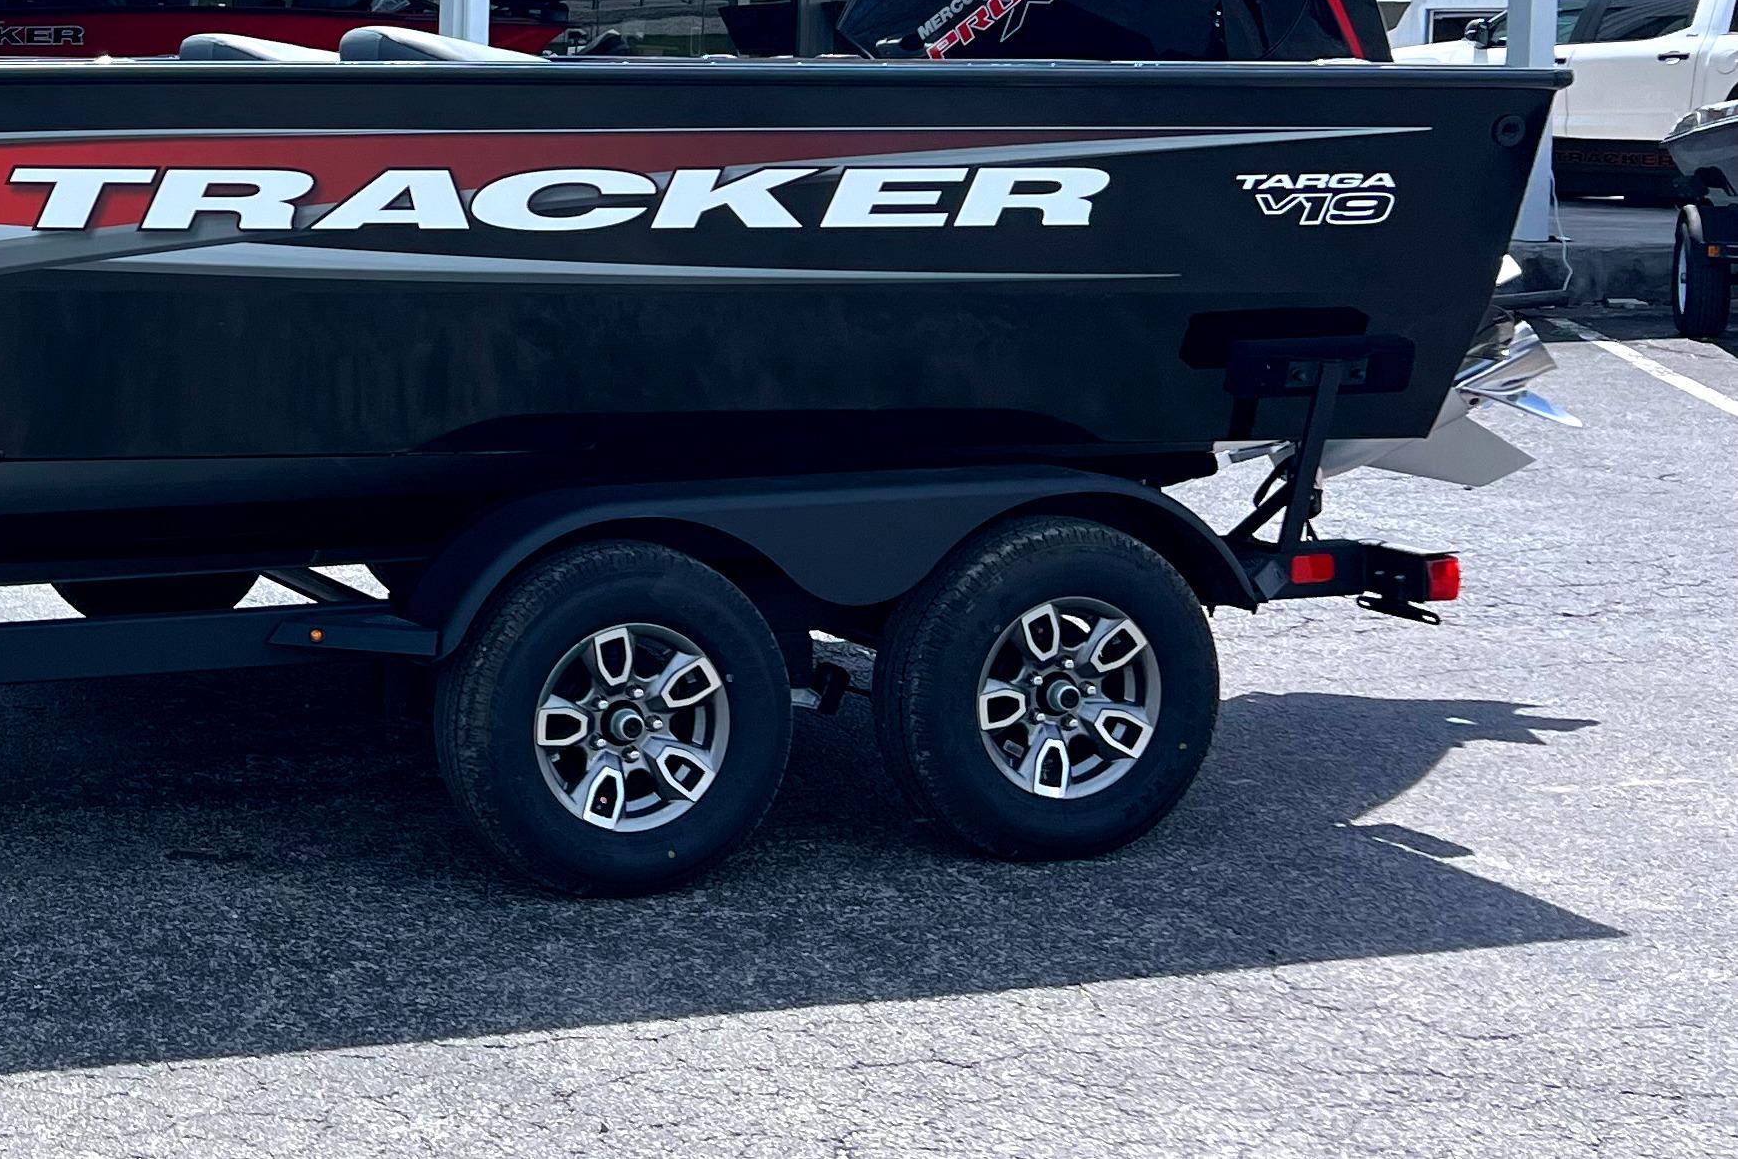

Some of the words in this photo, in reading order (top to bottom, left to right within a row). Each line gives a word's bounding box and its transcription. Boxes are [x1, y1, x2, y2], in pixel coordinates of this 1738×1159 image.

[7, 165, 1111, 231] TRACKER
[1236, 172, 1396, 189] TARGA
[1255, 191, 1396, 226] V19
